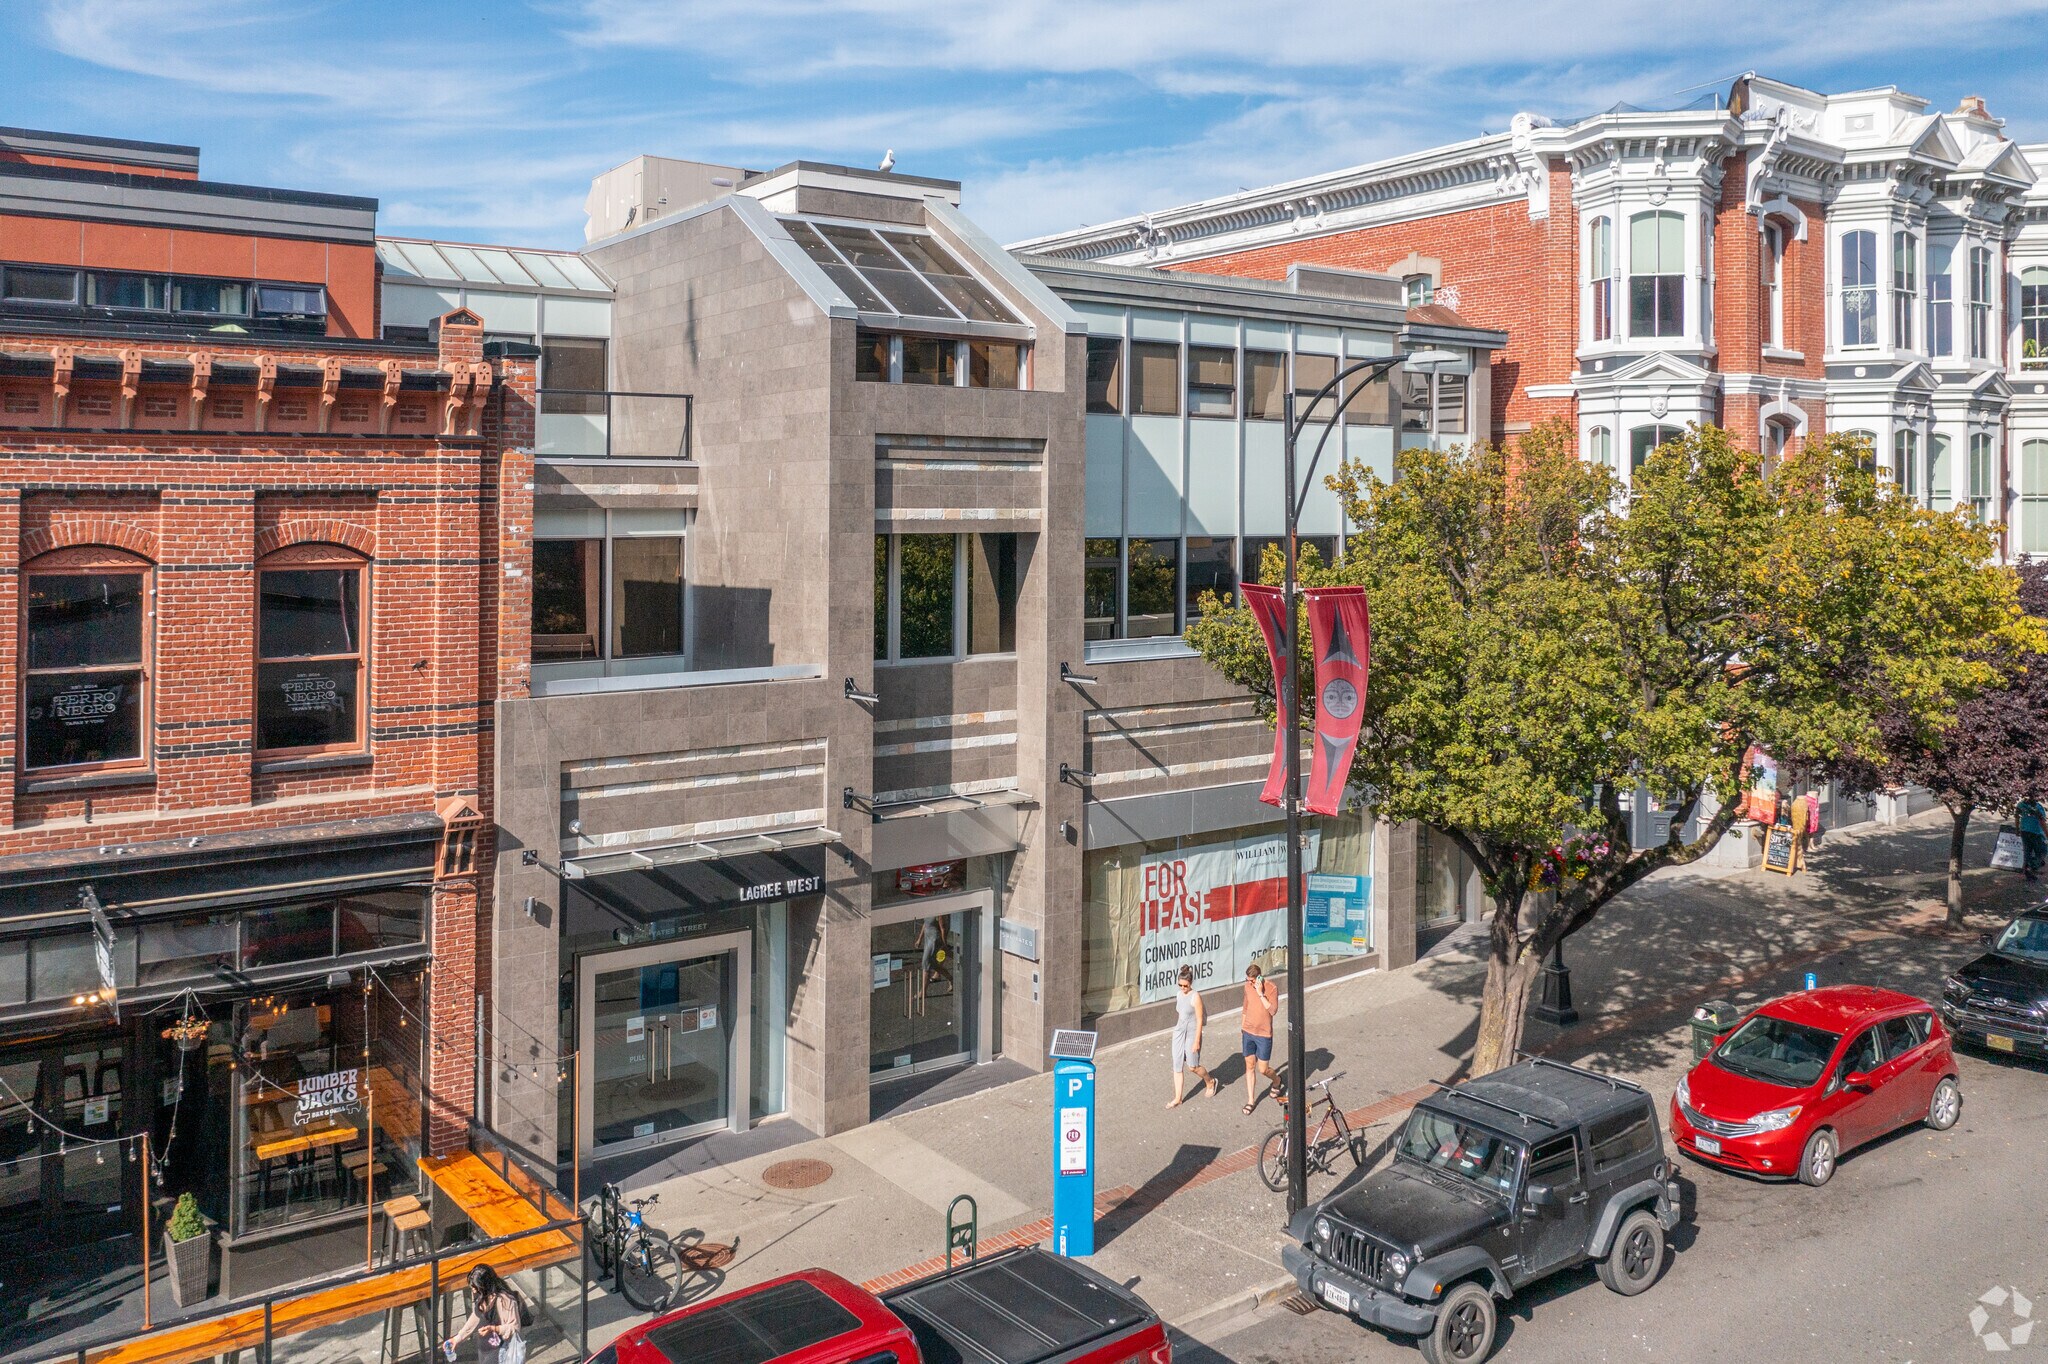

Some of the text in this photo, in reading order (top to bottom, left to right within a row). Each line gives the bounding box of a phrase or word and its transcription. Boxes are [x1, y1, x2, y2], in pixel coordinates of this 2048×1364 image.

[284, 680, 336, 692] PERRO
[57, 692, 116, 706] PERRO
[284, 691, 336, 703] NEGRO
[56, 703, 116, 717] NEGRO
[1236, 846, 1276, 860] WILLIAM
[739, 876, 820, 902] LAGREE WEST
[1145, 860, 1188, 902] FOR
[1145, 890, 1212, 934] LEASE
[678, 923, 708, 933] STREET
[1145, 934, 1221, 965] CONNOR BRAID
[1145, 968, 1178, 992] HARRY
[629, 1055, 646, 1063] PULL
[297, 1068, 358, 1094] LUMBER
[1068, 1078, 1083, 1098] P
[298, 1084, 358, 1111] JACK'S
[311, 1110, 324, 1119] BAR
